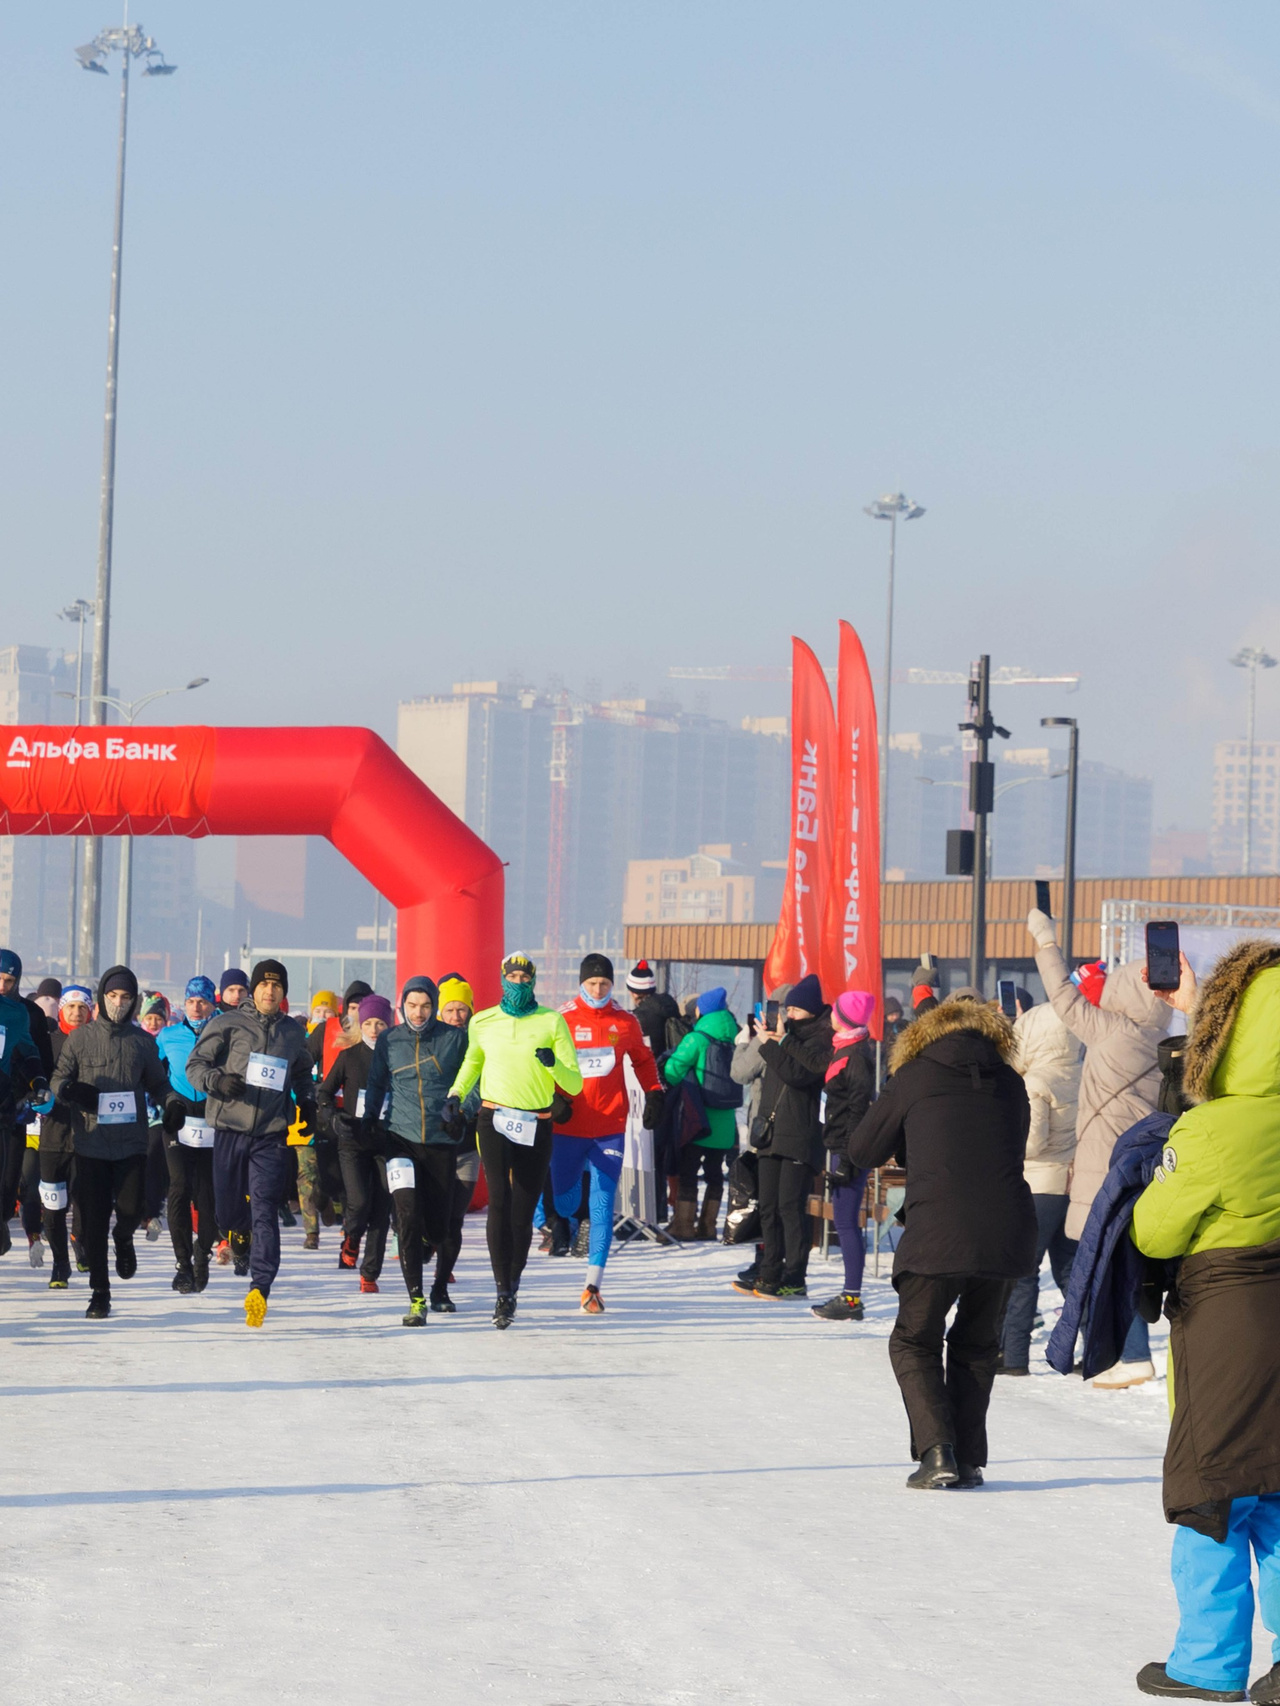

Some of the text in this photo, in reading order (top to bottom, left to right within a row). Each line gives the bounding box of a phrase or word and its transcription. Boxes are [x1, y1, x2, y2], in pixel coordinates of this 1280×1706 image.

[7, 736, 177, 765] Альфа Банк
[588, 1058, 602, 1069] 22
[261, 1066, 276, 1080] 82
[109, 1101, 125, 1112] 99
[506, 1121, 522, 1134] 88
[191, 1128, 203, 1140] 71
[44, 1192, 58, 1202] 60
